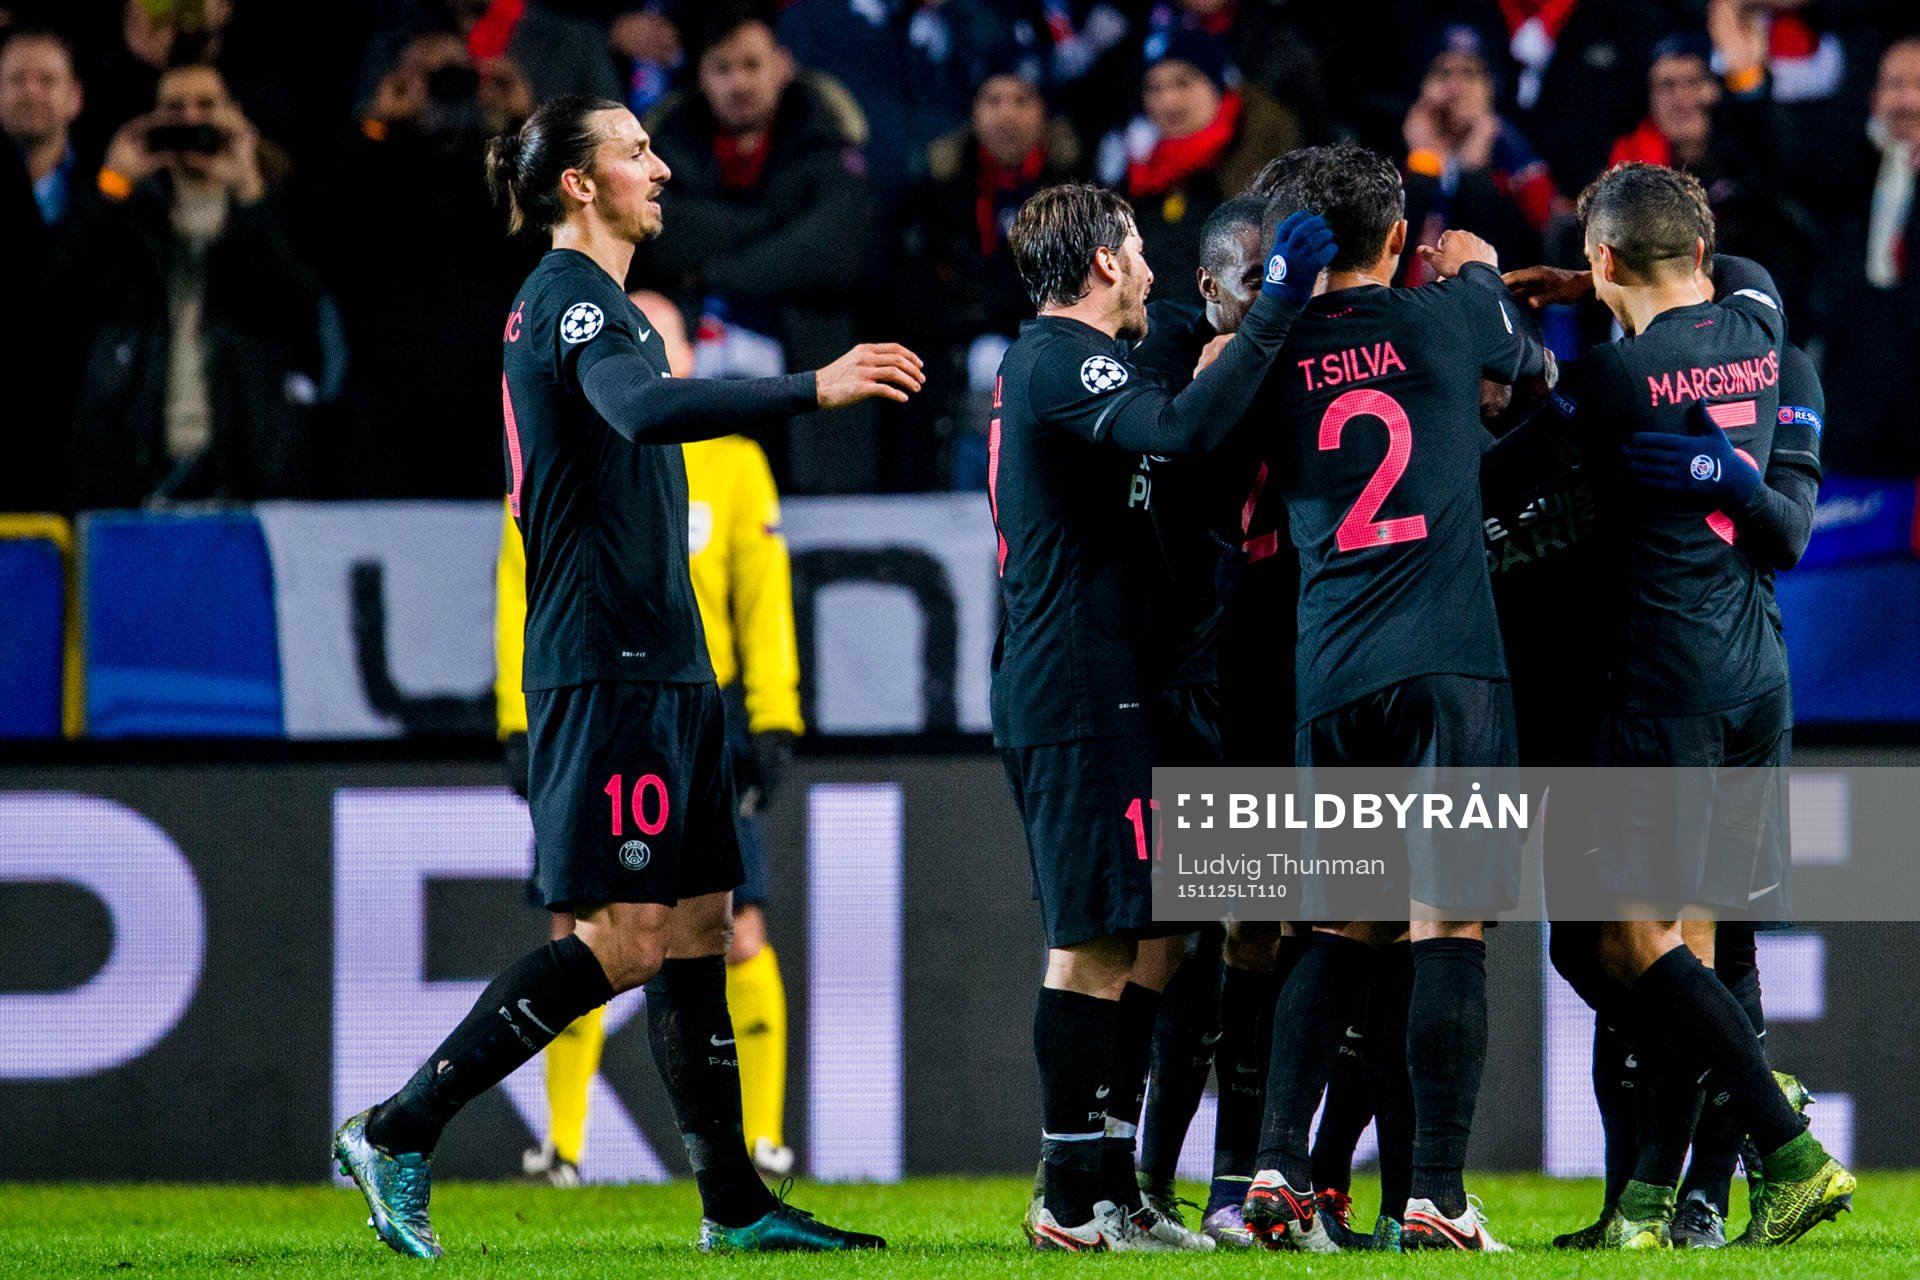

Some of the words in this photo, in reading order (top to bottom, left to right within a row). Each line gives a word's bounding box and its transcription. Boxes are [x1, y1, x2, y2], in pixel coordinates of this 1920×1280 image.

[1297, 341, 1407, 392] T.SILVA
[1647, 349, 1779, 408] MARQUINHOS
[1318, 387, 1429, 553] 2
[603, 773, 670, 836] 10
